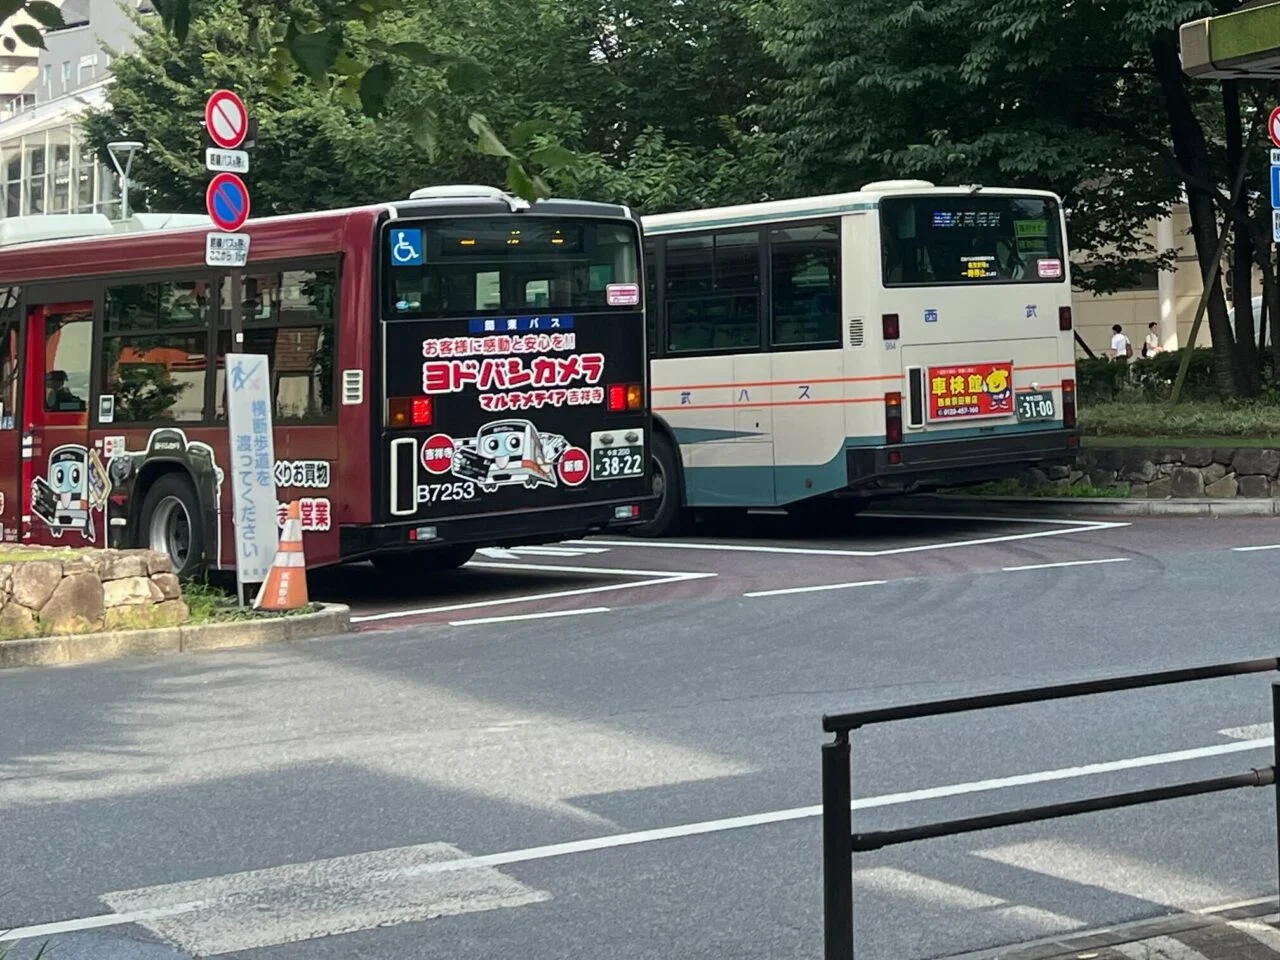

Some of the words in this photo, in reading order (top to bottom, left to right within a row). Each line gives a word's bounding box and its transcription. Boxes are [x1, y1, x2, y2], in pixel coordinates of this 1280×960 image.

[484, 318, 561, 331] 関東バス
[425, 354, 604, 392] ヨドバシカメラ
[931, 374, 983, 395] 車検館
[251, 400, 271, 487] 横断歩道を
[563, 459, 584, 473] 新宿
[600, 454, 642, 476] 38-22
[236, 435, 258, 558] 渡ってください
[417, 482, 475, 503] B7253
